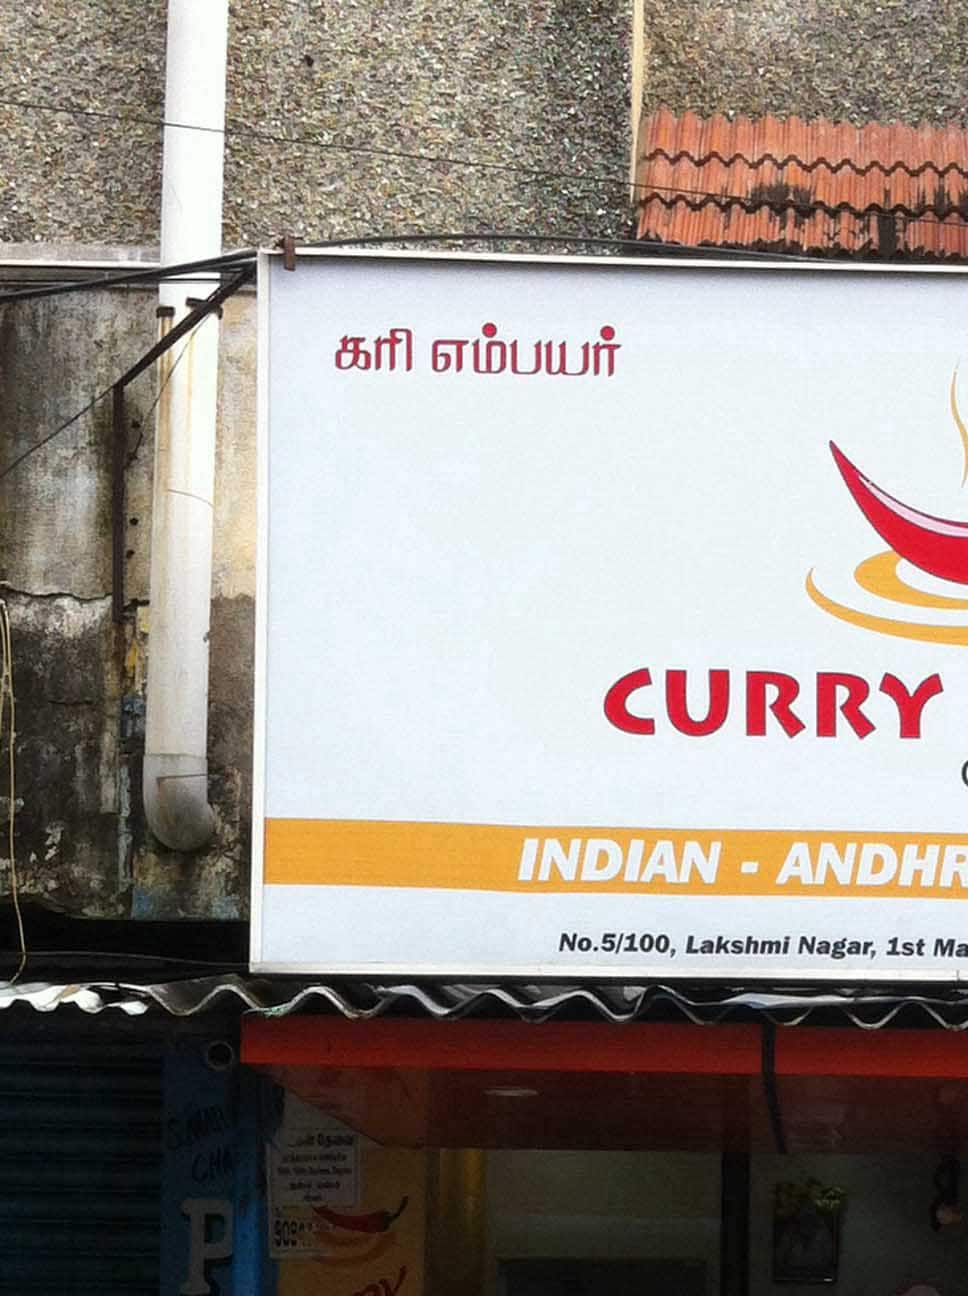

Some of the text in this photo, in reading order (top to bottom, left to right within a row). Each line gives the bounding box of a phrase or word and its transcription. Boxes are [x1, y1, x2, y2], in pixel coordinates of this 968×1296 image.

[335, 322, 622, 377] கரி எம்பயர்
[603, 667, 944, 740] CURRY
[517, 837, 723, 884] INDIAN
[559, 933, 676, 958] No.5/100,
[686, 935, 790, 956] Lakshmi
[799, 936, 876, 960] Nagar,
[886, 936, 925, 957] 1st
